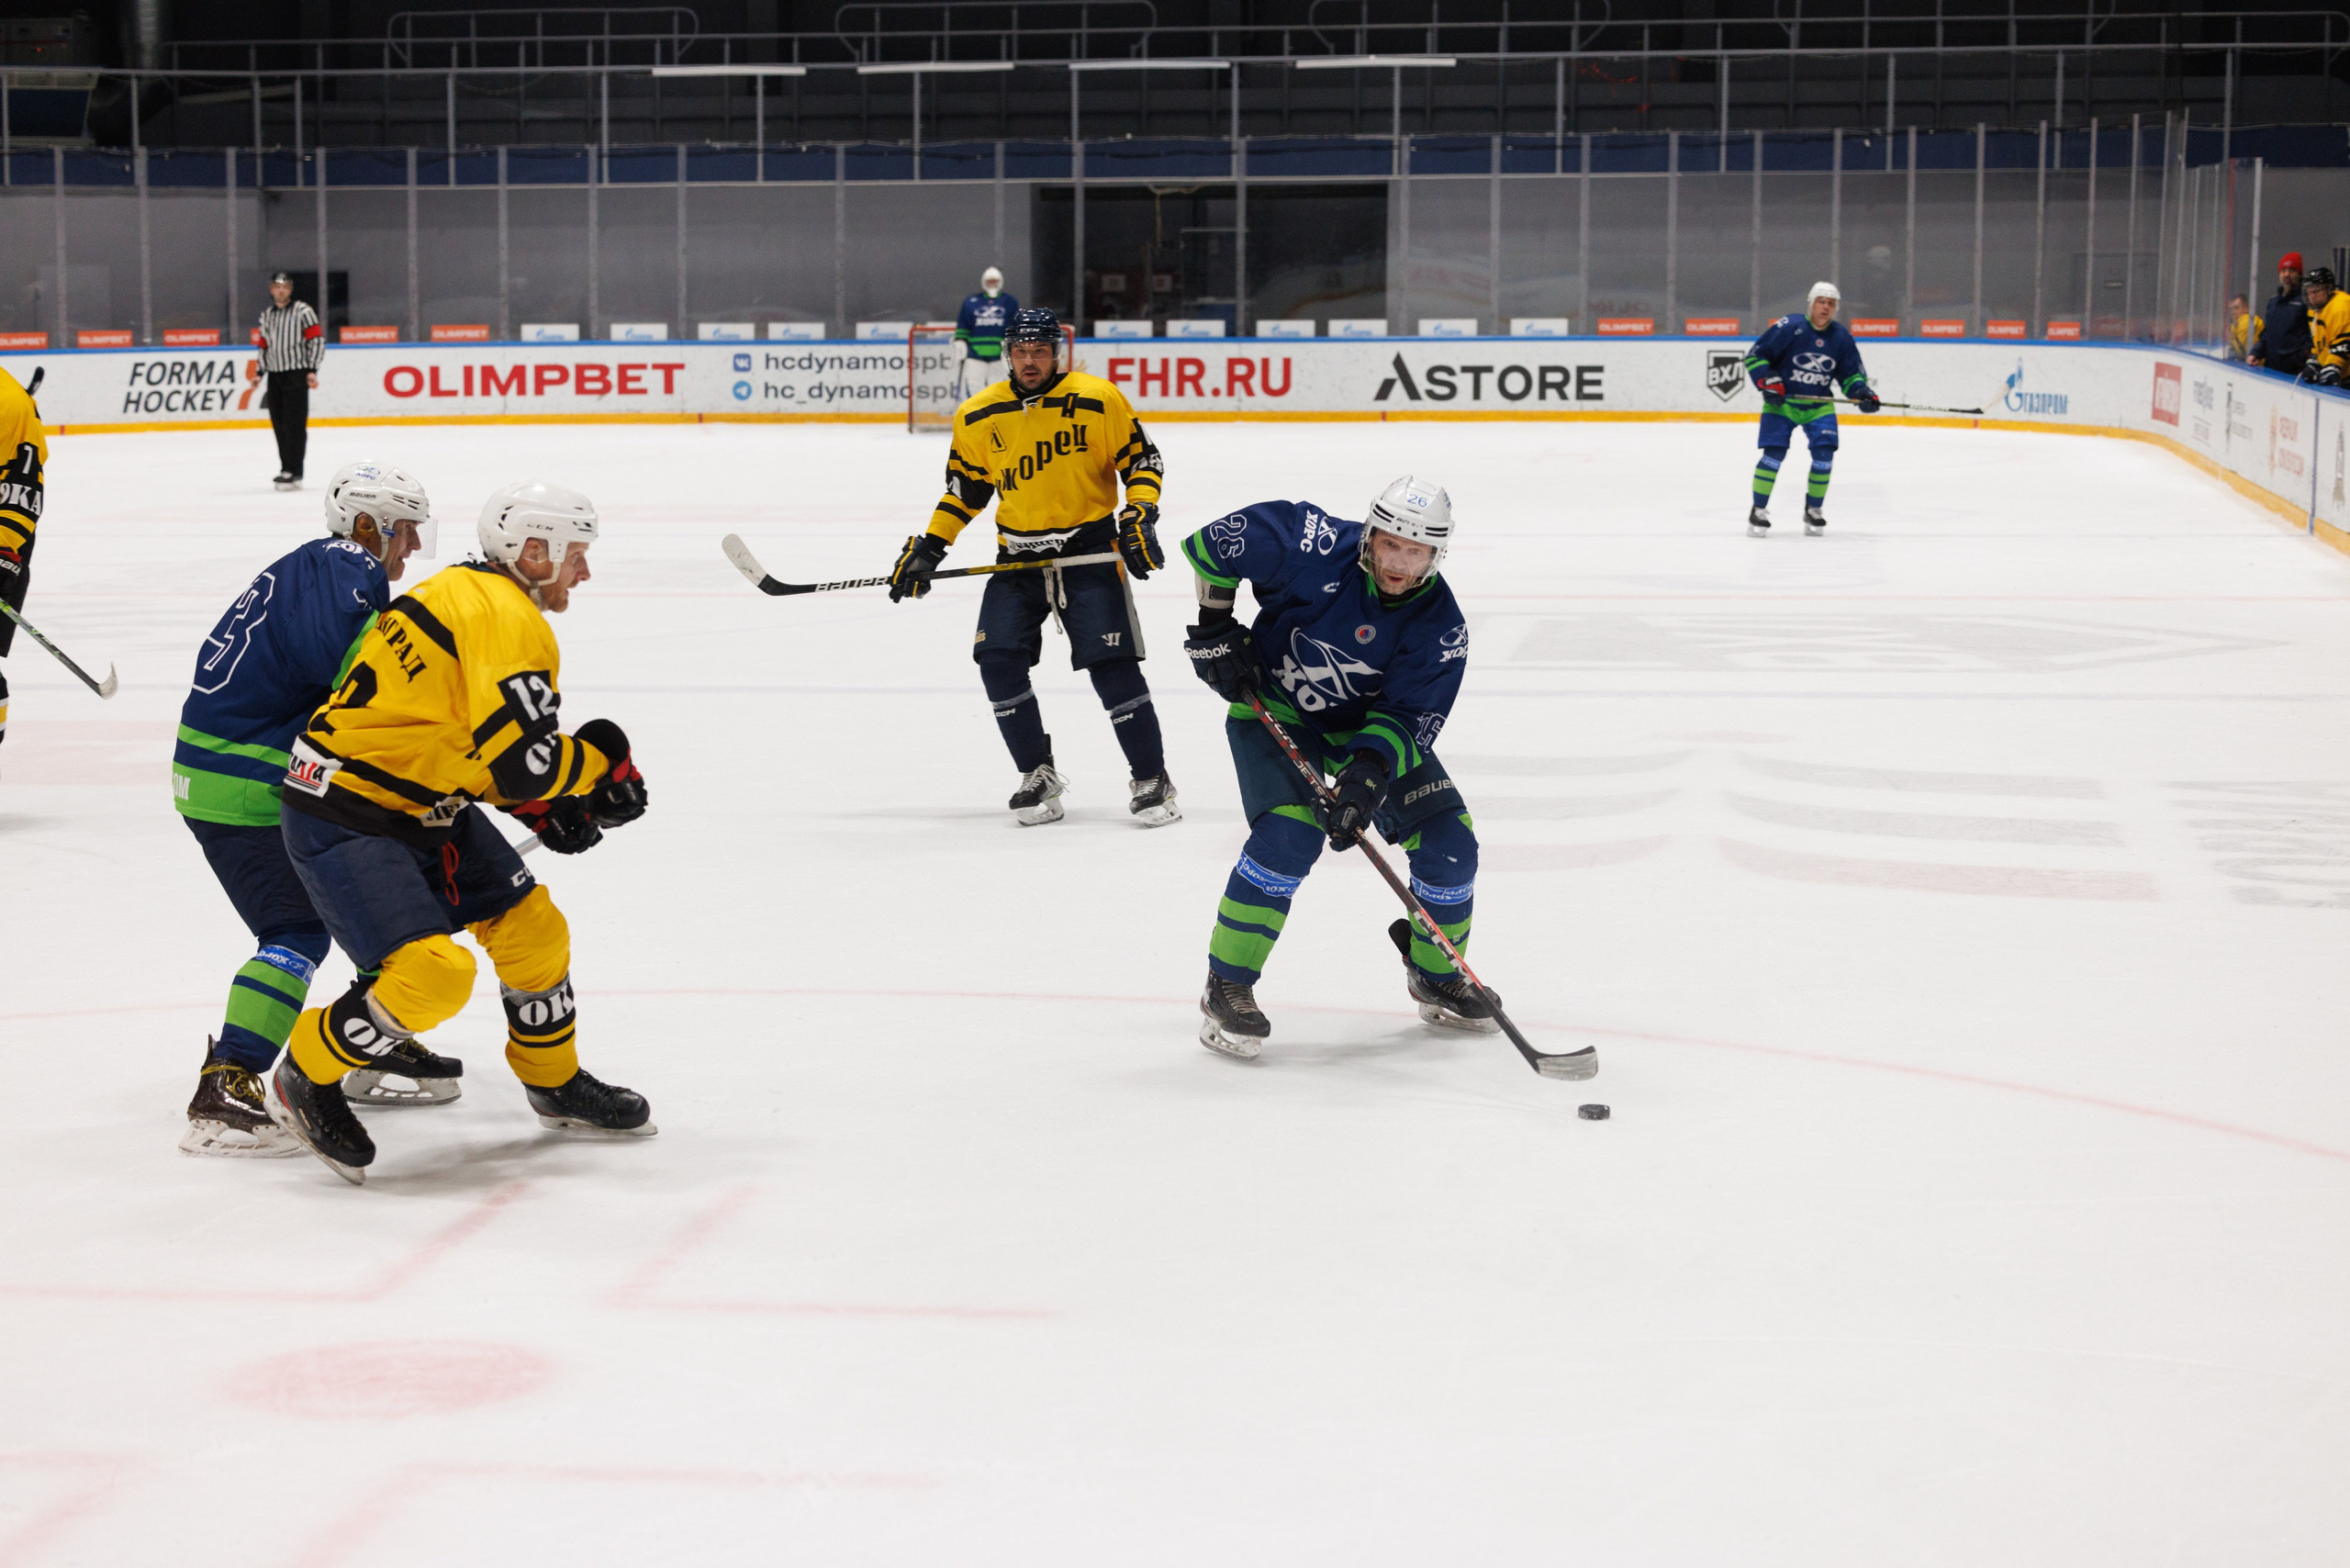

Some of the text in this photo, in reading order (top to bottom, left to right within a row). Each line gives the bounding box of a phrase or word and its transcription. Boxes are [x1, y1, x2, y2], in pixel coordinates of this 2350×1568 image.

[432, 329, 488, 339] OLIMPBET
[1598, 322, 1652, 331] OLIMPBET
[1686, 322, 1738, 332] OLIMPBET
[1852, 323, 1897, 333] OLIMPBET
[165, 332, 218, 342] OLIMPBET
[341, 330, 397, 340] OLIMPBET
[129, 361, 235, 386] FORMA
[383, 363, 686, 398] OLIMPBET
[1108, 357, 1292, 398] FHR.RU
[1374, 352, 1604, 401] ASTORE
[1707, 364, 1744, 386] ВХЛ
[1789, 369, 1831, 386] ХОРС
[123, 388, 234, 413] HOCKEY
[1406, 493, 1428, 508] 26
[1209, 514, 1248, 559] 26
[1300, 510, 1319, 554] ХОРС
[814, 576, 890, 592] BAUER
[1184, 643, 1232, 659] Reebok
[508, 675, 557, 722] 12
[995, 707, 1016, 717] CCM
[1113, 712, 1135, 724] CCM
